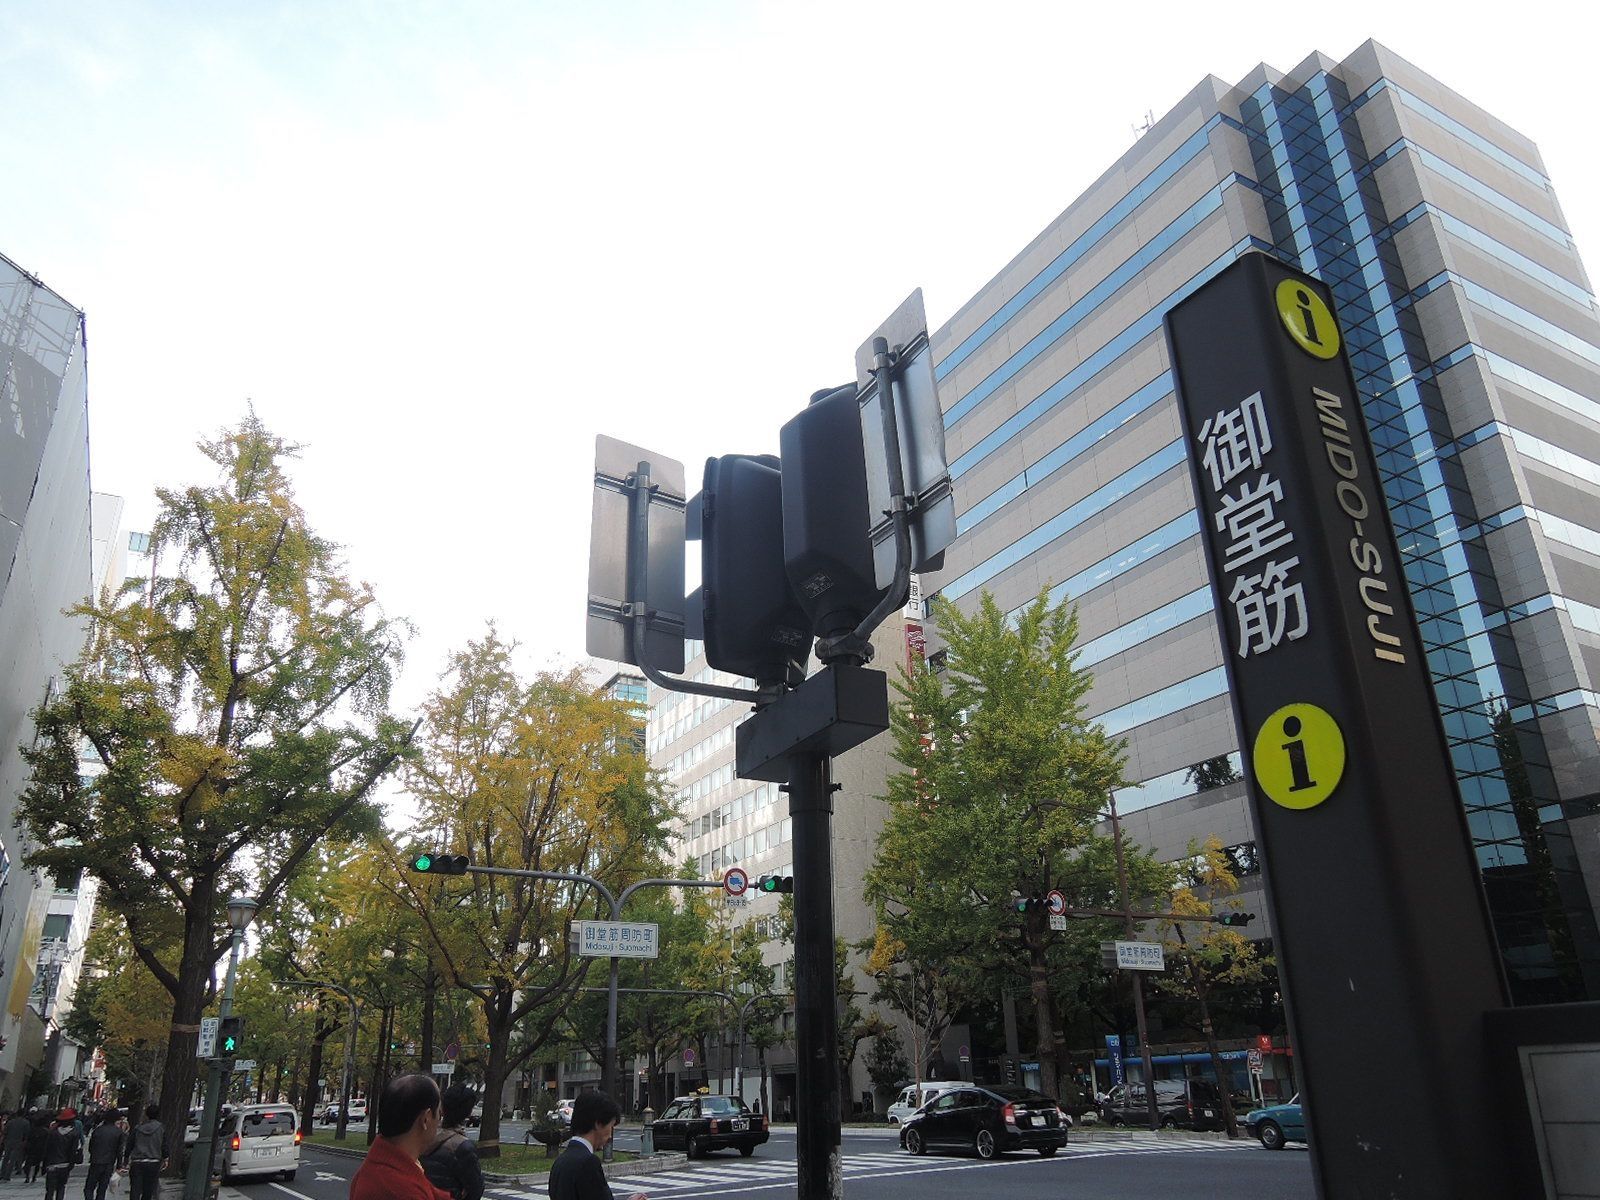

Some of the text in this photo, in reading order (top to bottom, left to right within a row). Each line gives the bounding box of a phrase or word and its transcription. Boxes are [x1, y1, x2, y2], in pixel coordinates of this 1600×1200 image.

[1197, 389, 1309, 660] 御堂筋
[1311, 385, 1406, 665] MIDO-SUJI
[584, 926, 654, 943] 御堂筋周防町
[585, 942, 652, 953] Midosuji Suomachi
